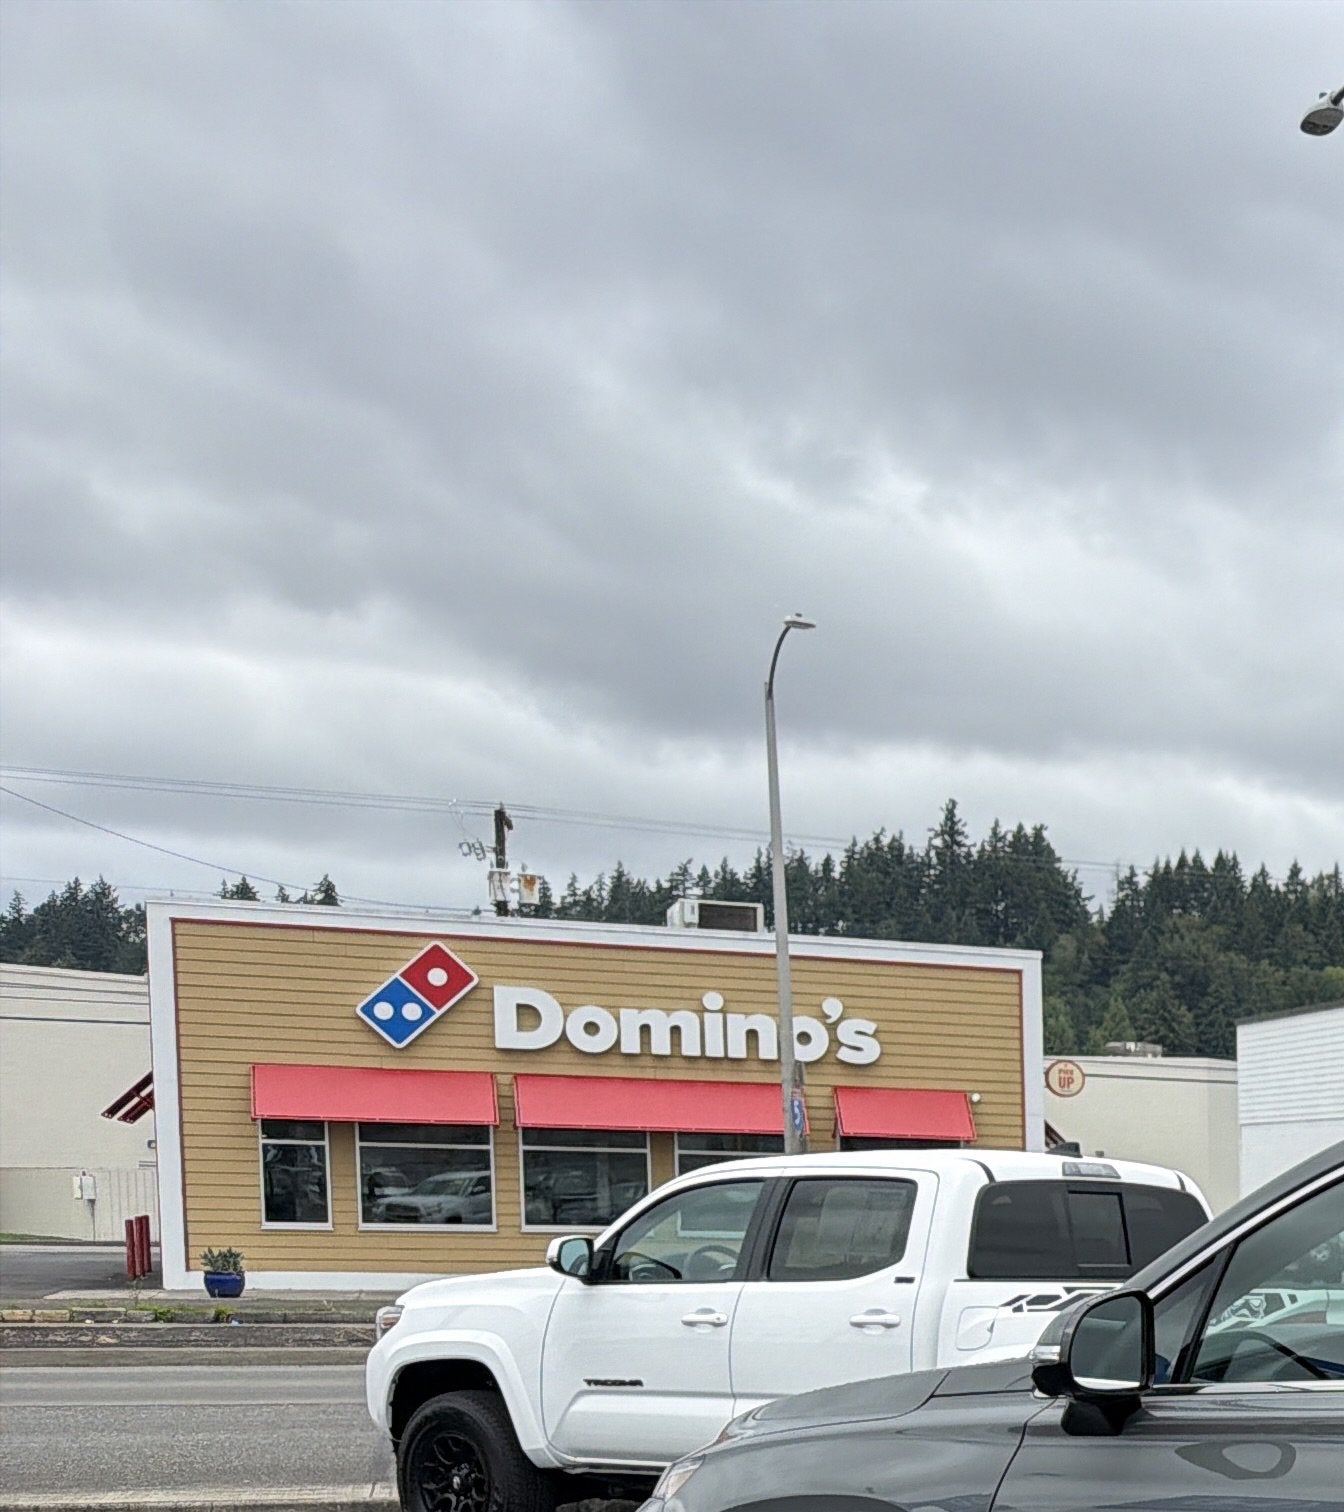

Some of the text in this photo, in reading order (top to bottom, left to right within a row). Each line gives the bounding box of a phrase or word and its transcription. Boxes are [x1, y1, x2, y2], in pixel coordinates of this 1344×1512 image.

[493, 985, 882, 1065] Domino's
[1058, 1076, 1074, 1088] UP
[583, 1378, 644, 1387] TACOMA
